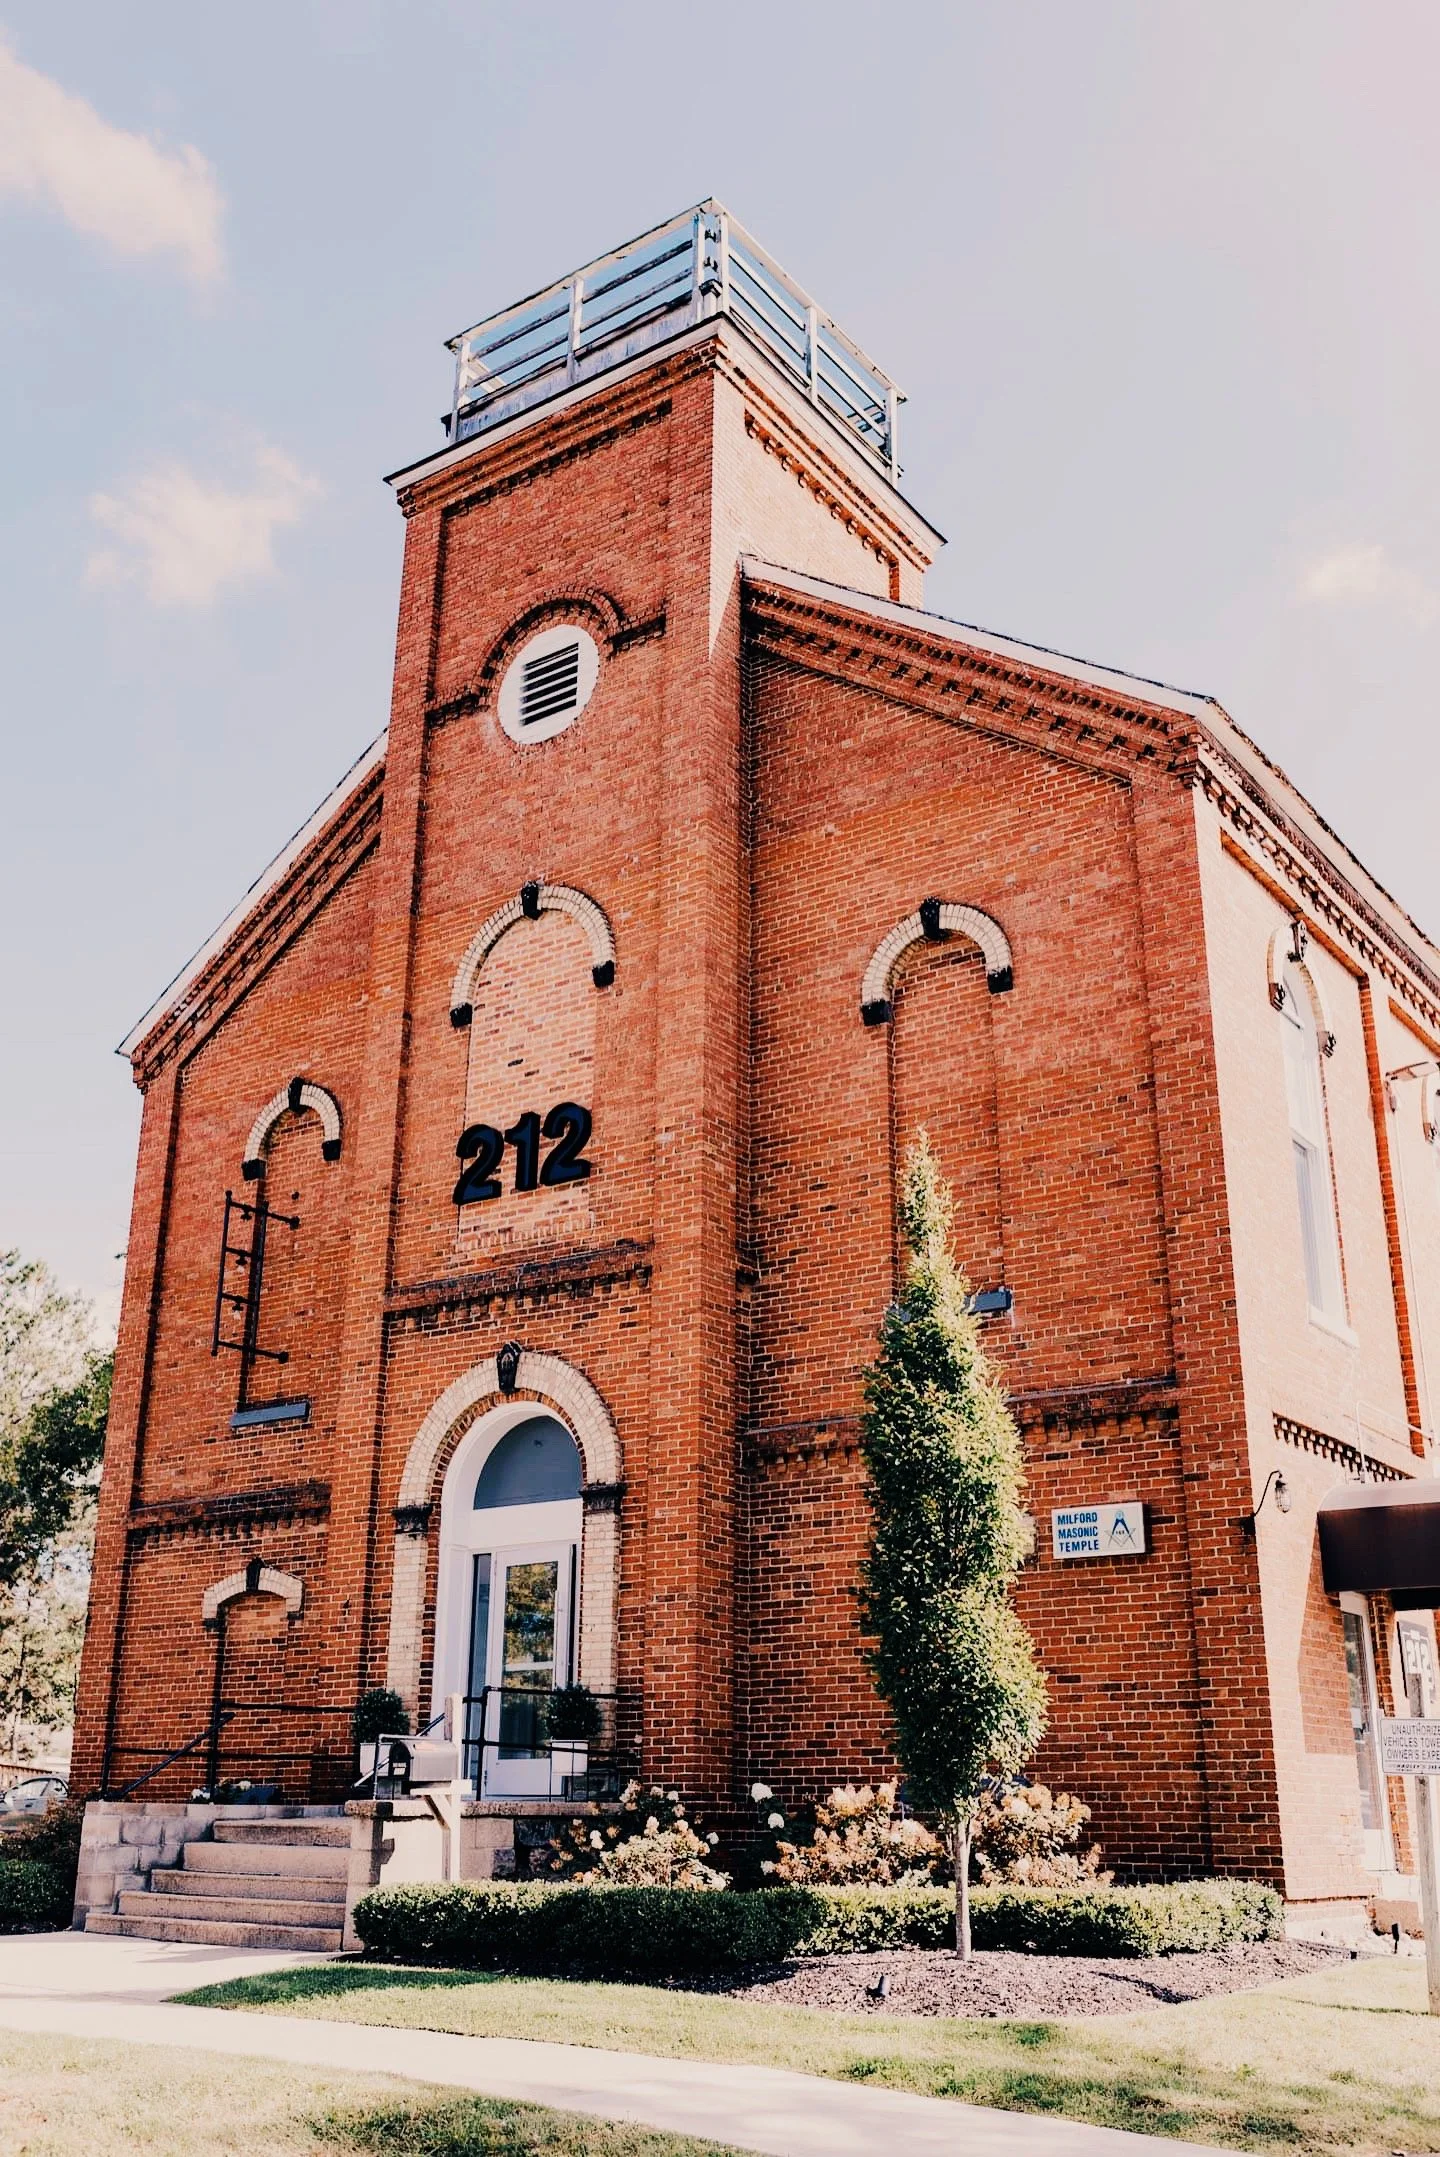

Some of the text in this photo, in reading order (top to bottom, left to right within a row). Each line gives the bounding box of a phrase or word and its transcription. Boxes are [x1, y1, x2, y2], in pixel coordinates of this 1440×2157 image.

[452, 1102, 592, 1206] 212
[1057, 1512, 1098, 1525] MILFORD
[1058, 1526, 1098, 1539] MASONIC
[1059, 1539, 1099, 1552] TEMPLE
[1383, 1736, 1418, 1747] VEHICLES
